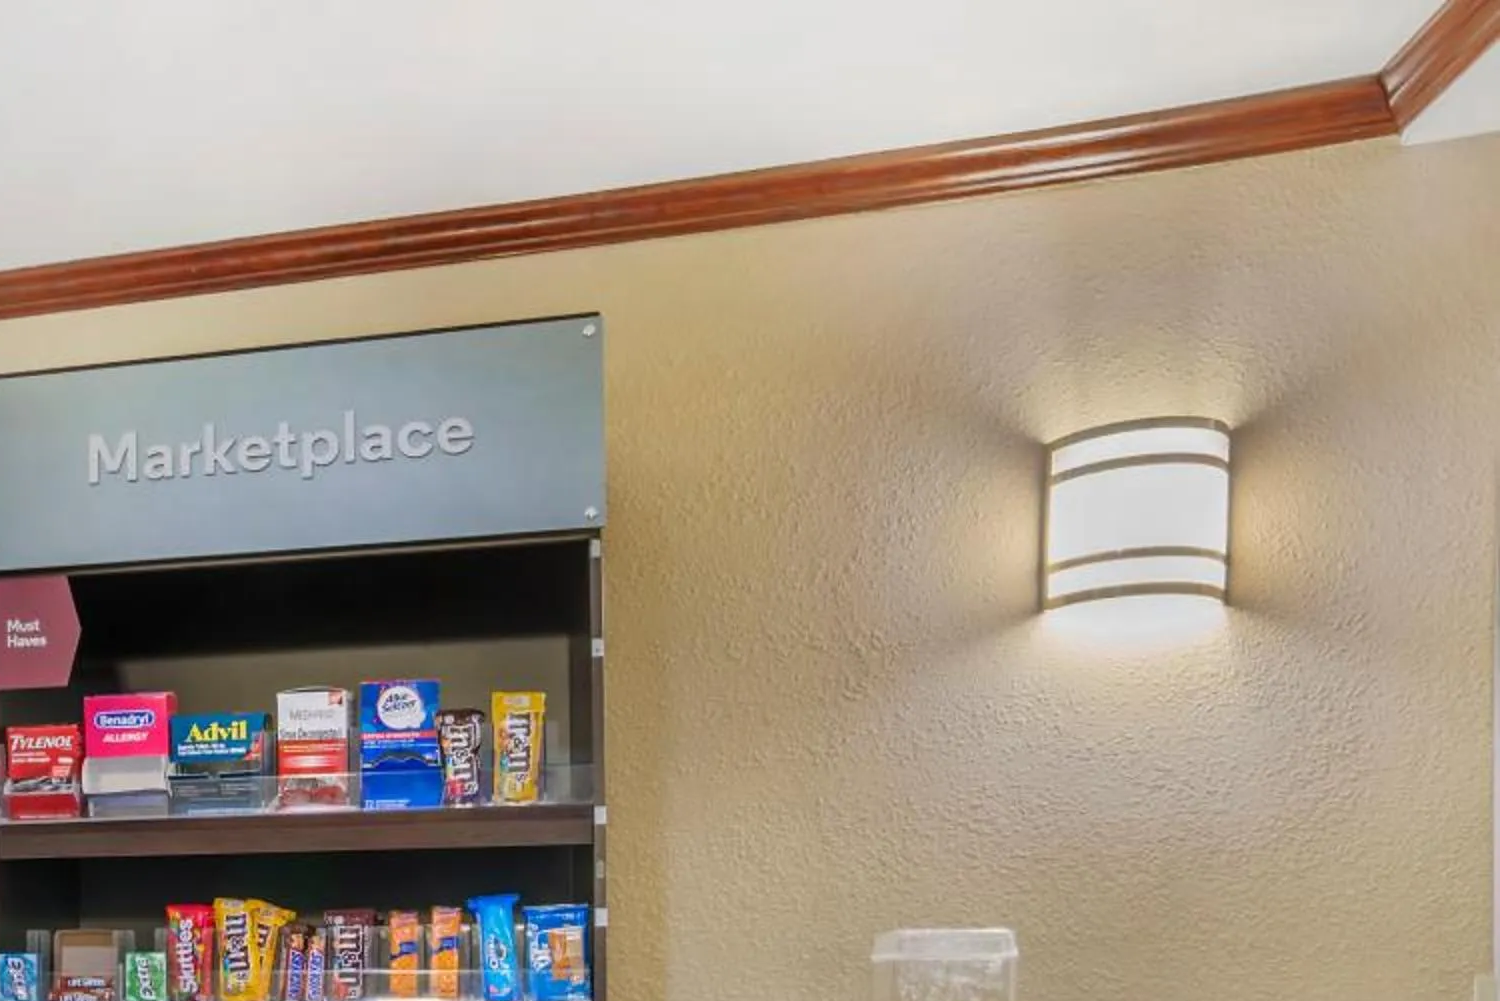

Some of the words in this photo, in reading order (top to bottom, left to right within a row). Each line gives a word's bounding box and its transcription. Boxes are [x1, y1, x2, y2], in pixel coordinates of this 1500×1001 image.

[87, 409, 476, 486] Marketplace
[7, 618, 40, 633] Must
[7, 634, 47, 648] Haves
[99, 713, 150, 728] Benadryl
[102, 731, 149, 743] ALLERGY
[184, 719, 248, 743] Advil
[10, 735, 74, 751] TYLENOL
[177, 918, 198, 994] Skittles
